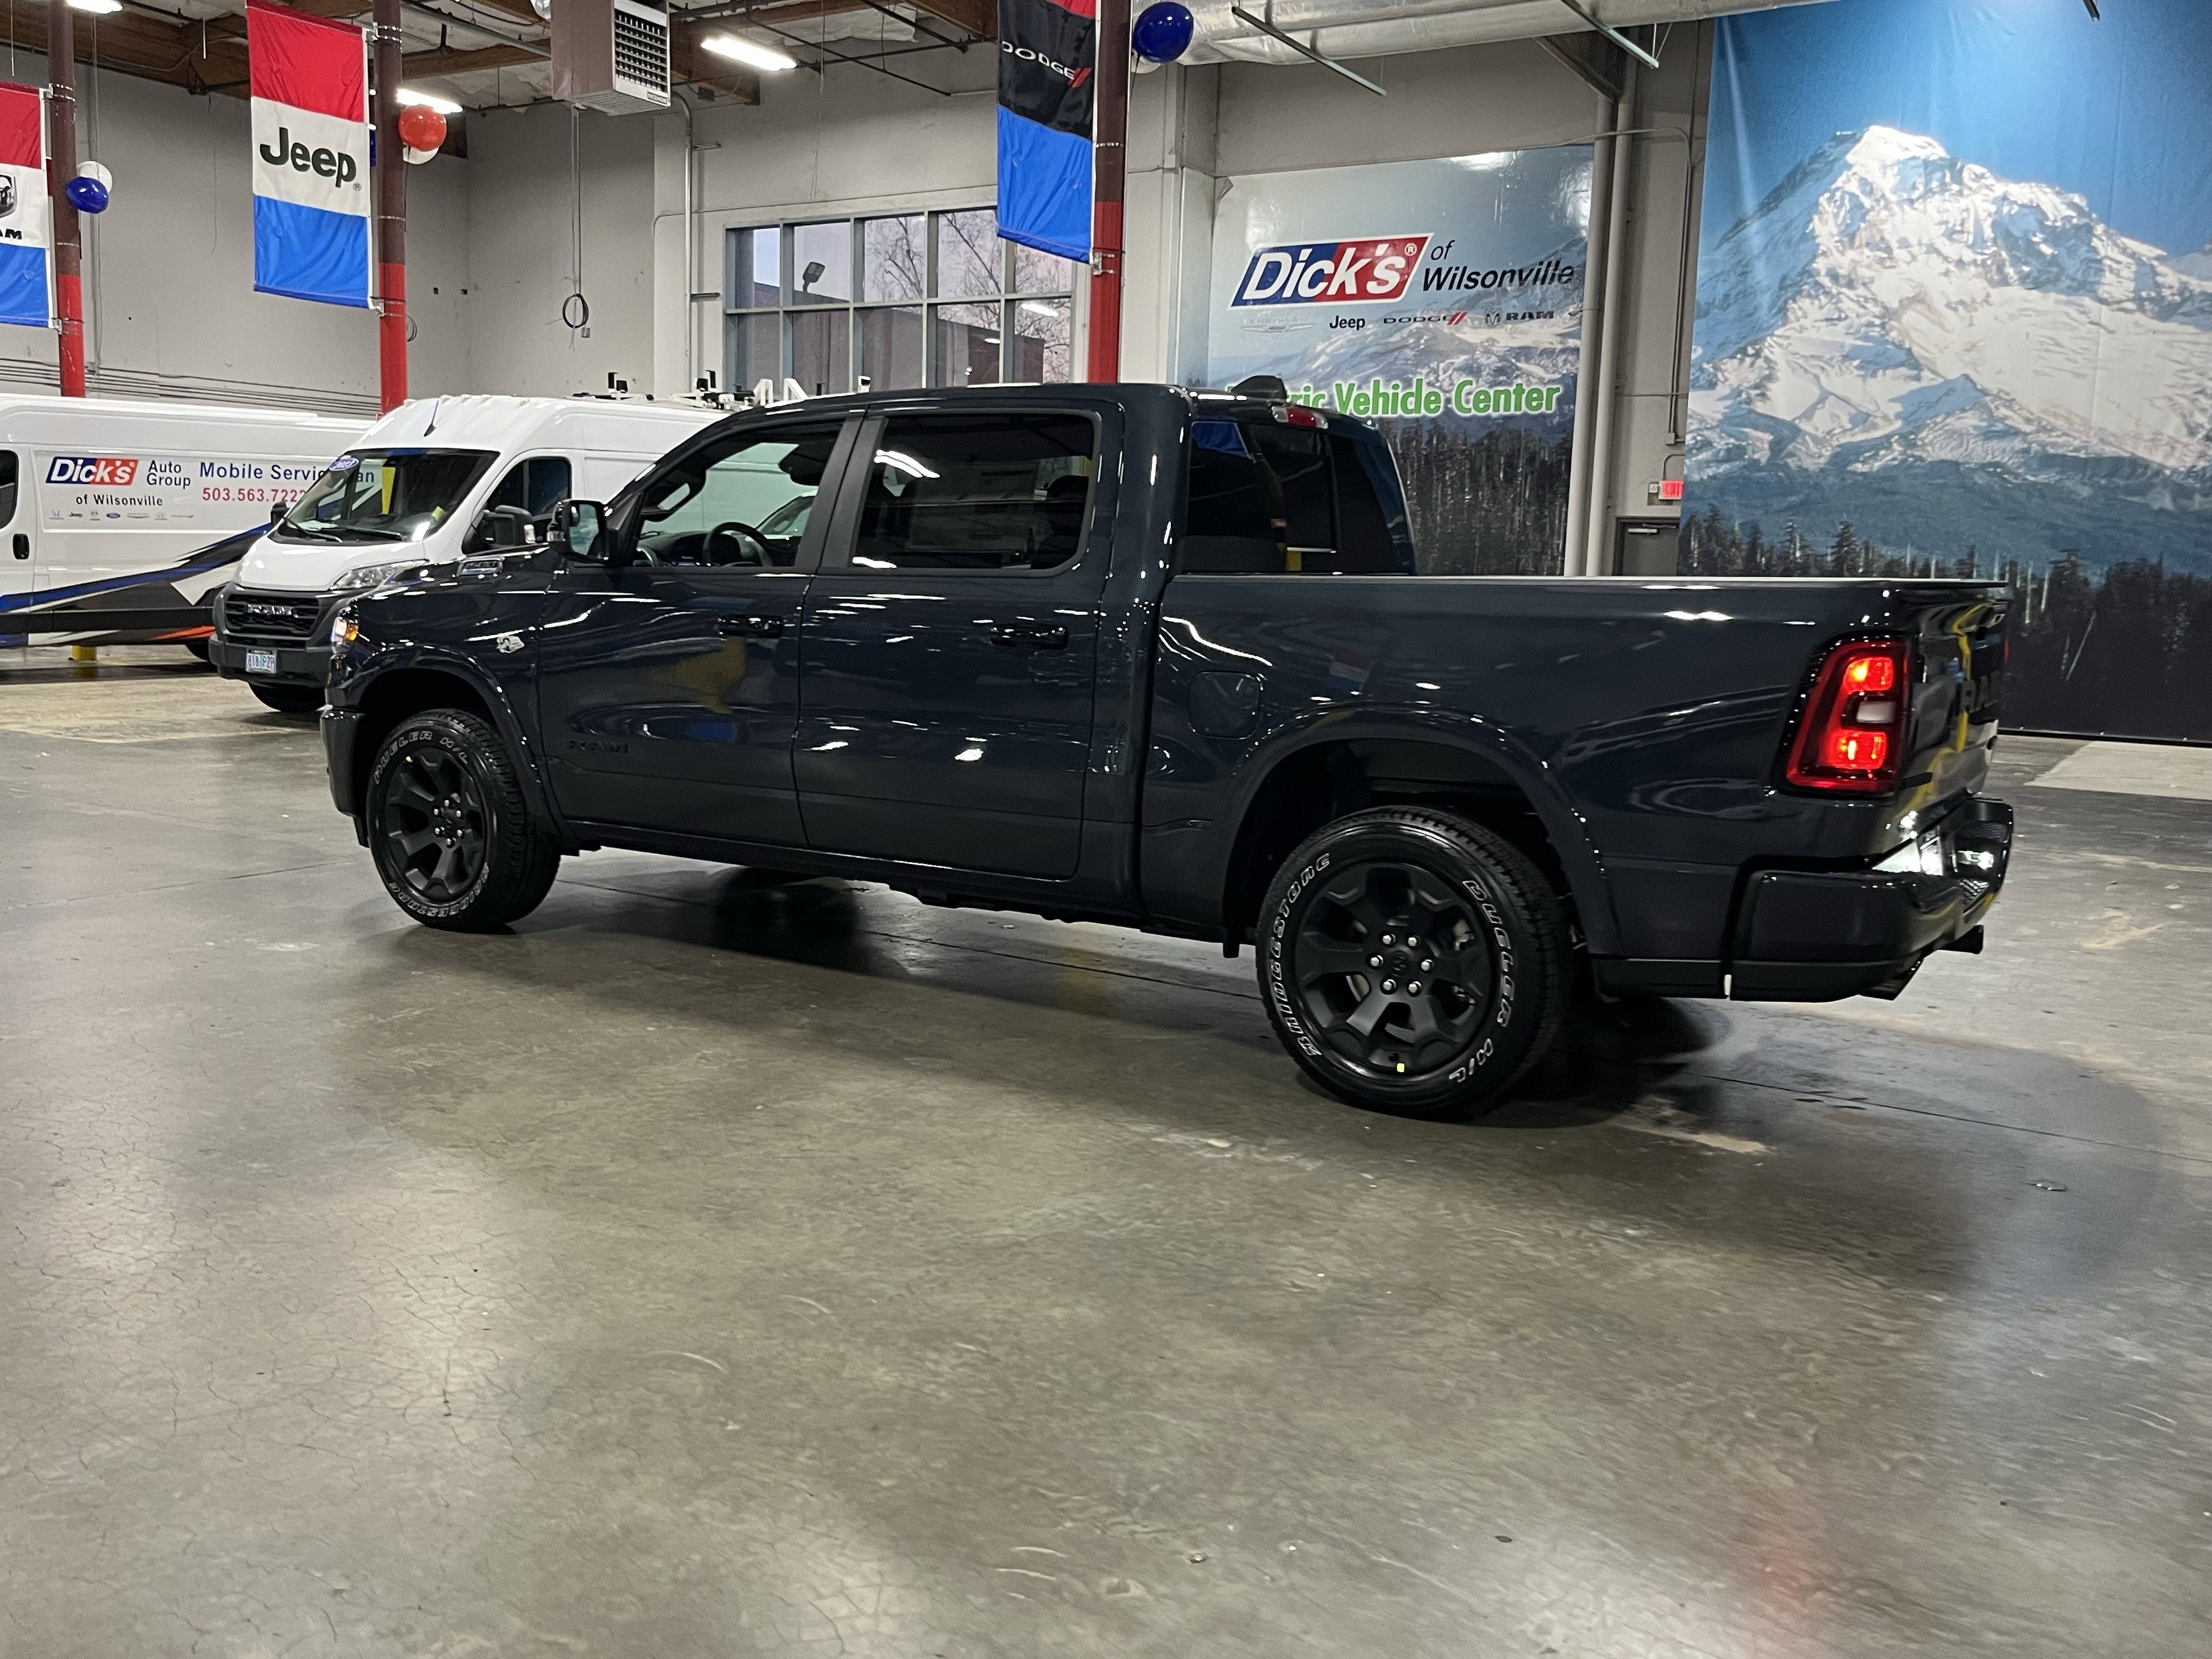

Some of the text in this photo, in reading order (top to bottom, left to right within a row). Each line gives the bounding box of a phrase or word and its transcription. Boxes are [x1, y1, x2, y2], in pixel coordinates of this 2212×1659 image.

[1002, 41, 1075, 80] DODGE
[259, 127, 357, 188] Jeep
[1430, 240, 1455, 260] of
[1423, 258, 1575, 291] Wilsonville
[1329, 315, 1365, 330] Jeep
[1383, 314, 1454, 324] DODGE
[1505, 311, 1554, 321] RAM
[1335, 379, 1442, 415] Vehicle
[1454, 380, 1560, 414] Center
[148, 460, 182, 473] Auto
[200, 462, 263, 478] Mobile
[270, 464, 325, 481] Servic
[146, 473, 191, 489] Group
[76, 494, 163, 506] of Wilsonville
[1270, 853, 1330, 1056] BRIDGESTONE
